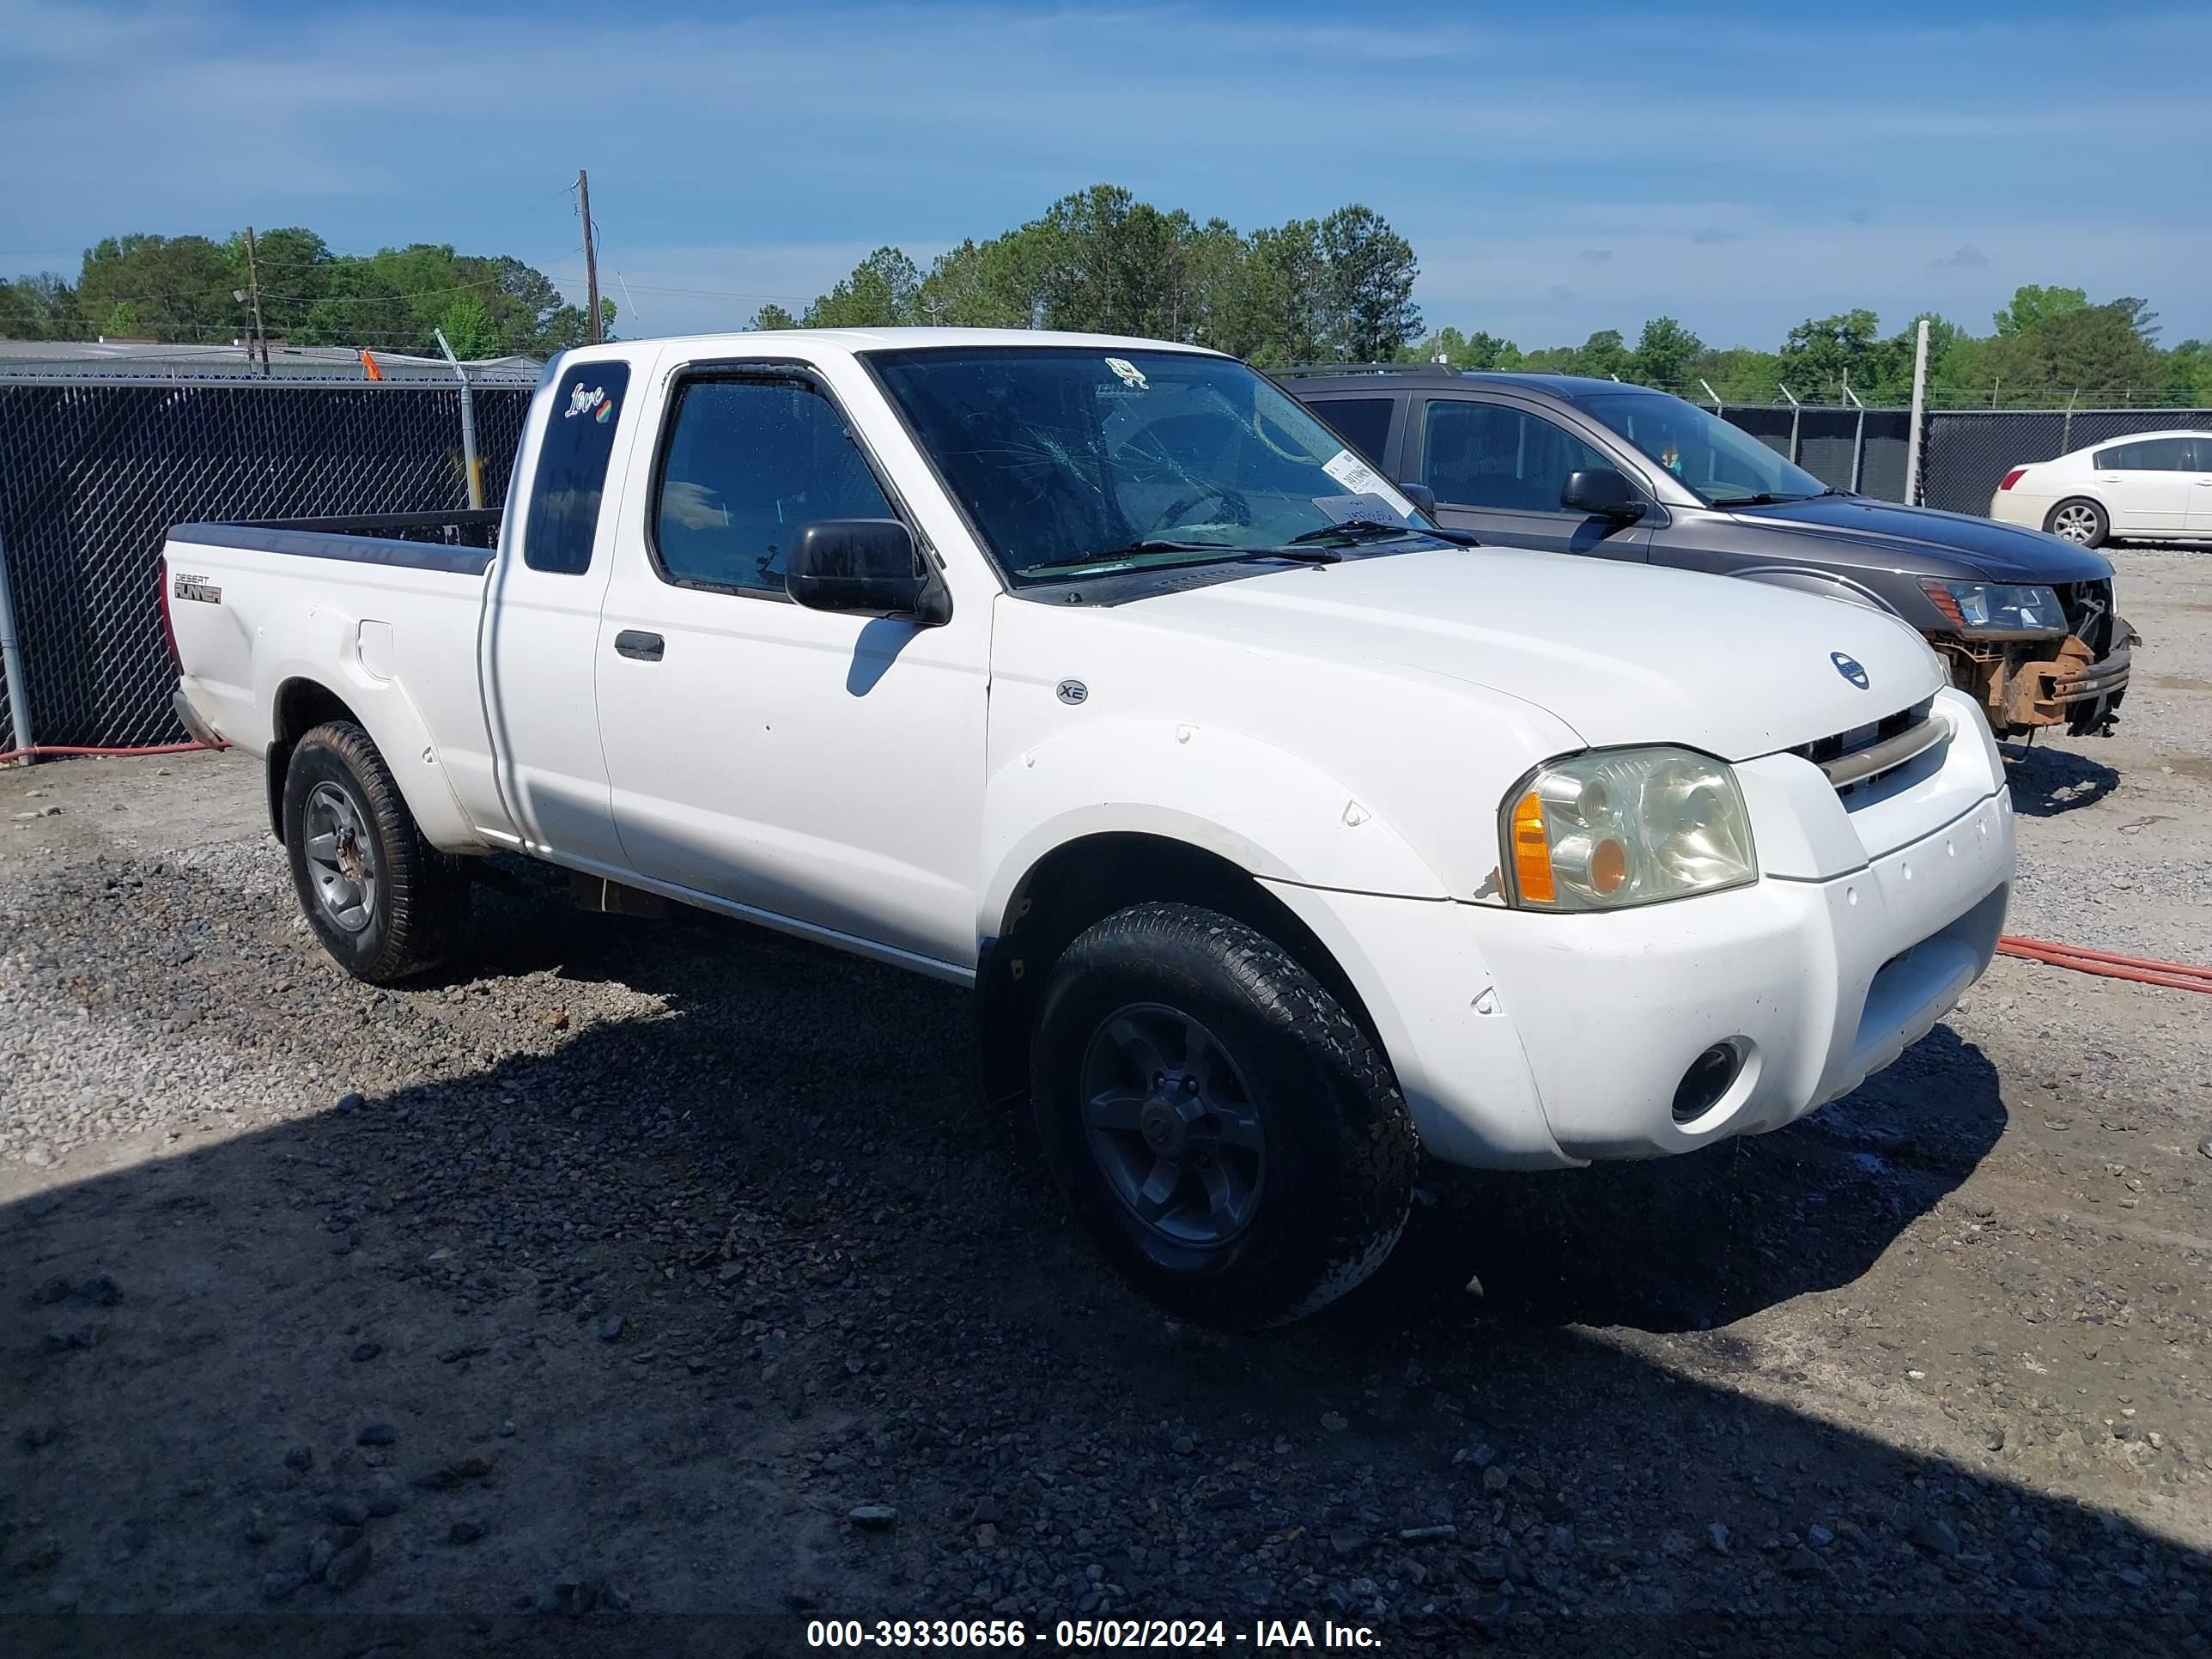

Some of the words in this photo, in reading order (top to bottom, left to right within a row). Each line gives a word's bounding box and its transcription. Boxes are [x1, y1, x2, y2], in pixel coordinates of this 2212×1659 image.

[175, 573, 210, 584] DESERT
[174, 582, 222, 605] RUNNER
[1059, 684, 1085, 700] XE
